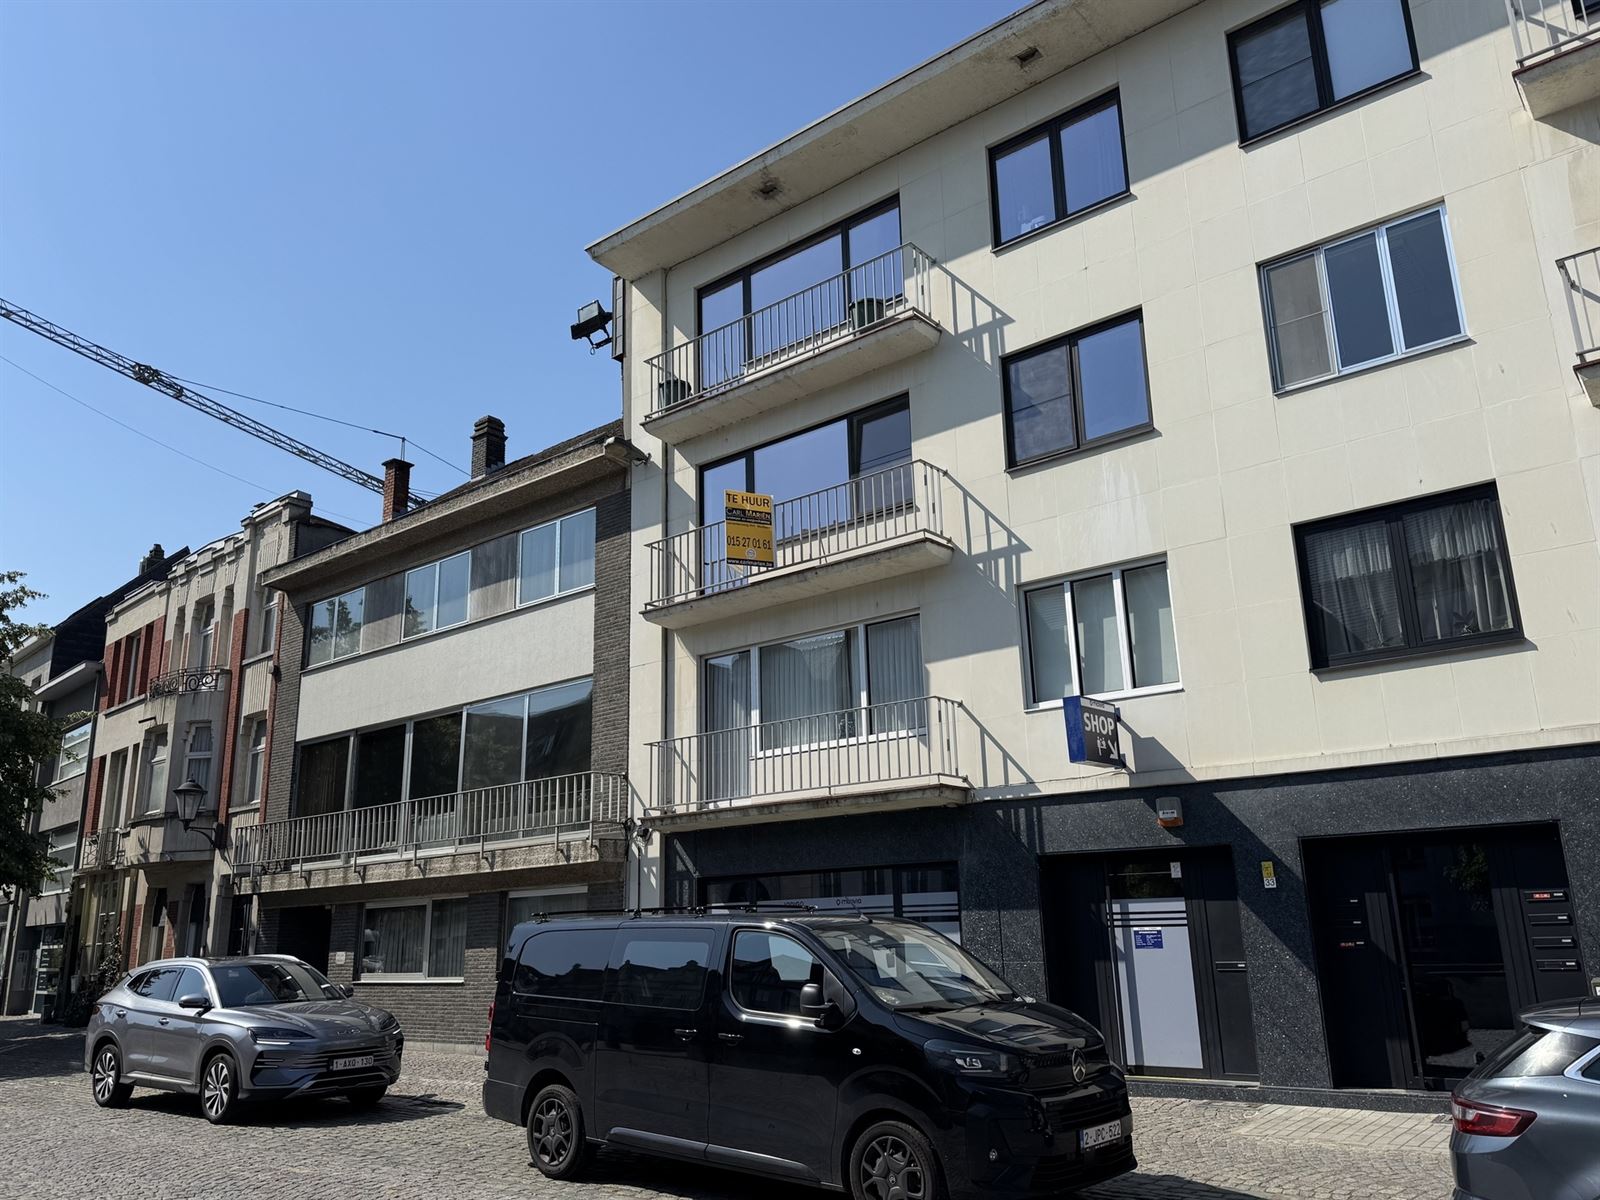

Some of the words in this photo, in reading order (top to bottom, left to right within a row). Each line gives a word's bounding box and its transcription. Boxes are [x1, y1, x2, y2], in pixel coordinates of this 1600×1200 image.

[726, 493, 738, 504] TE
[741, 495, 770, 508] HUUR
[726, 508, 744, 517] CARL
[726, 535, 740, 547] 015
[741, 536, 751, 548] 27
[752, 538, 761, 549] 01
[762, 539, 772, 550] 61
[1083, 711, 1115, 736] SHOP
[1265, 878, 1275, 887] 33
[1084, 1122, 1121, 1146] 2-JPC-522
